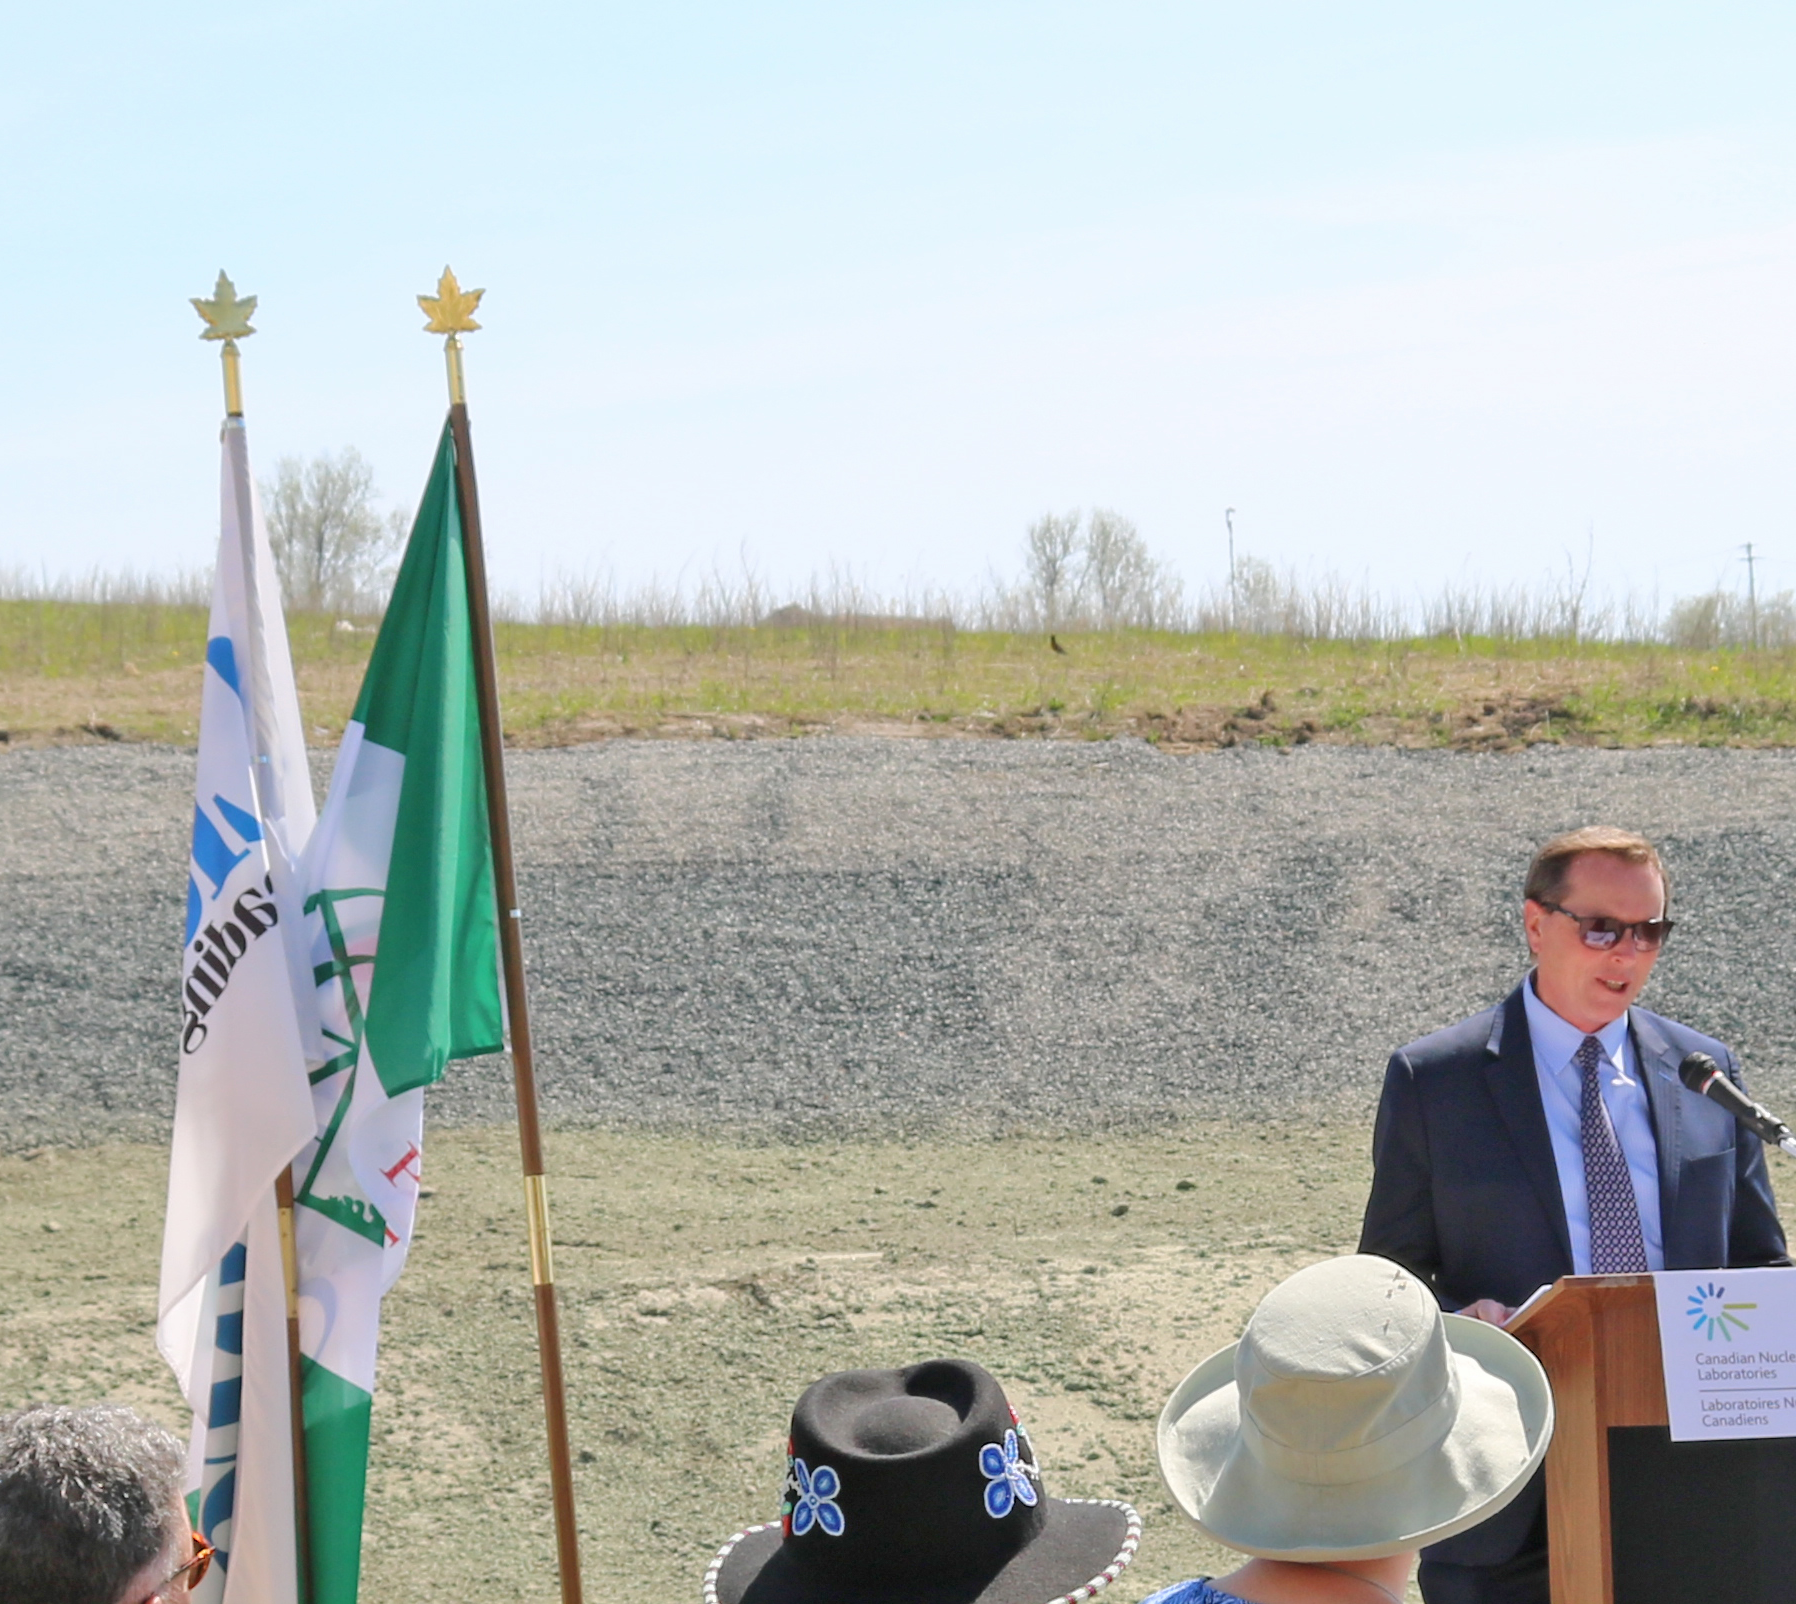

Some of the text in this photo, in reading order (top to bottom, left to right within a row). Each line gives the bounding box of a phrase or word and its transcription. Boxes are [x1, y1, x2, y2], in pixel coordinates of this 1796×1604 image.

[1695, 1351, 1755, 1366] Canadian
[1698, 1367, 1777, 1381] Laboratories
[1701, 1397, 1780, 1412] Laboratoires
[1702, 1414, 1769, 1427] Canadiens
